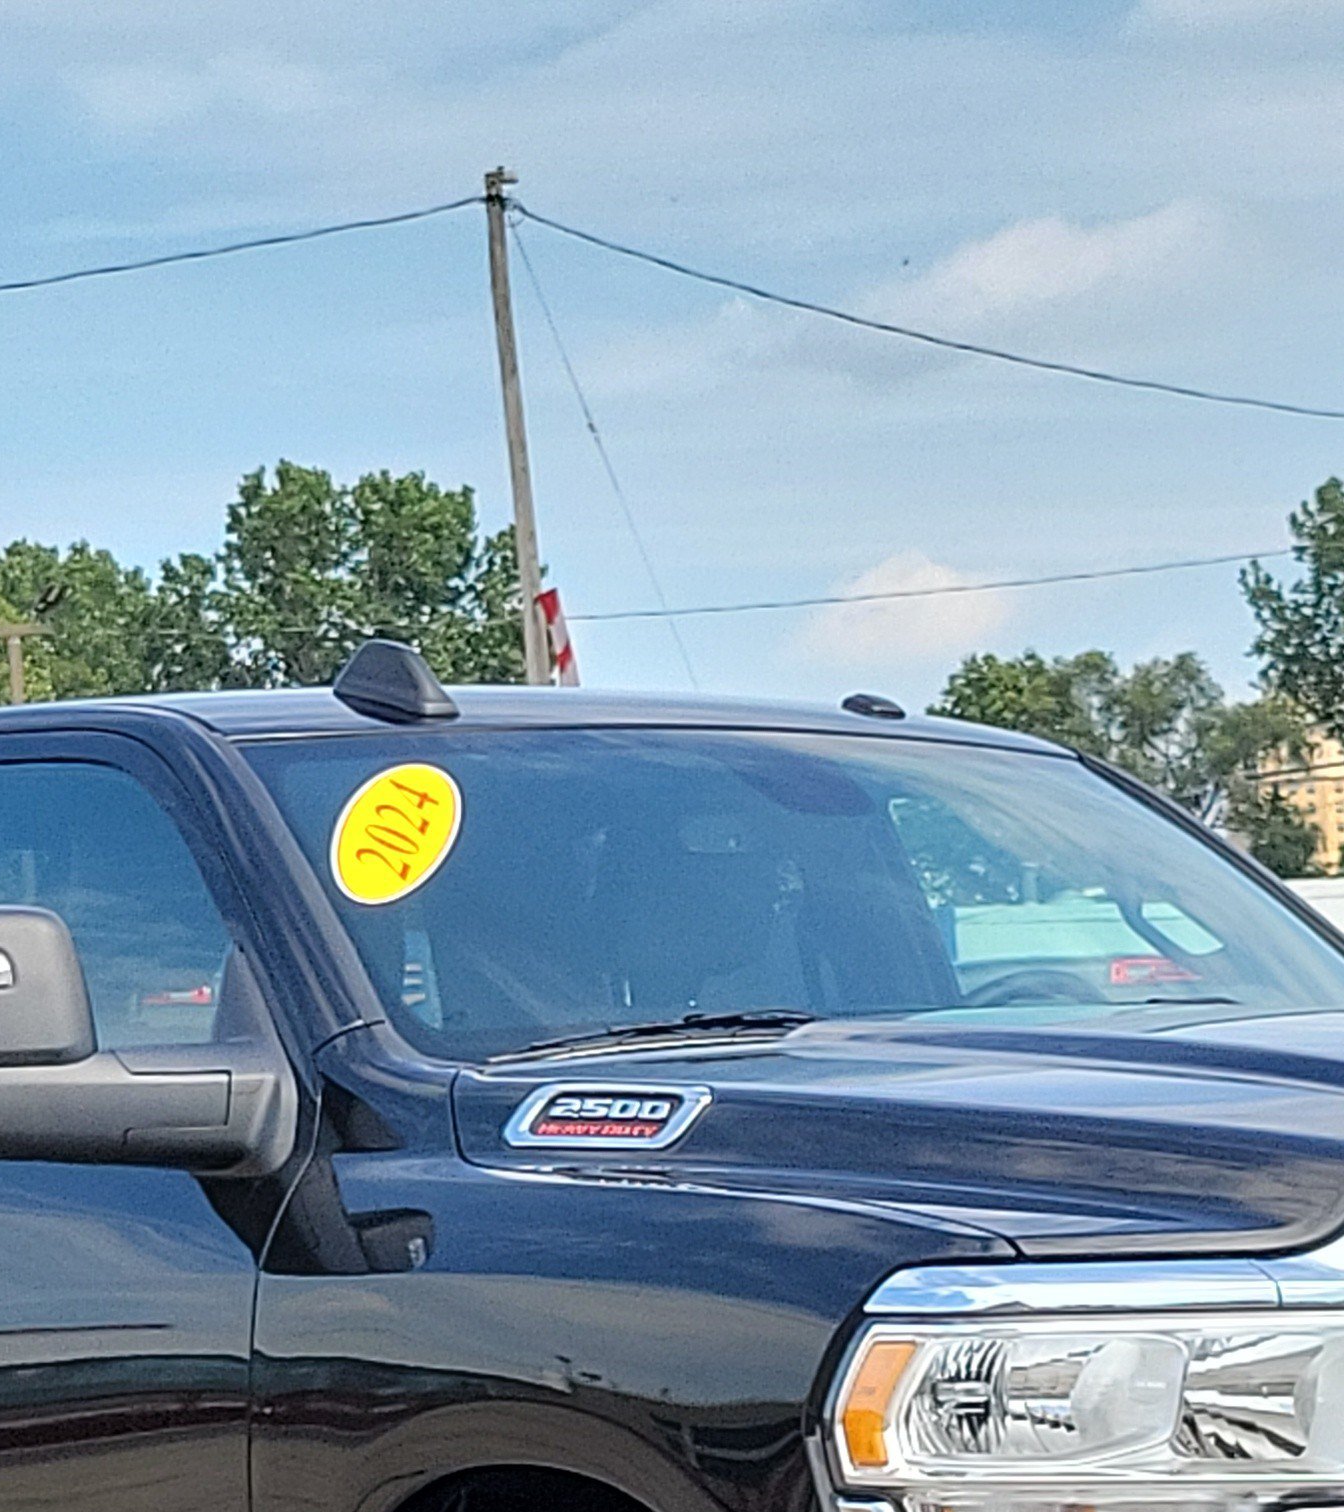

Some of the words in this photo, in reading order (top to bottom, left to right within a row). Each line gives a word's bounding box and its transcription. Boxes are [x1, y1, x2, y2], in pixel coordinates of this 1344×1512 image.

[355, 778, 440, 881] 2024
[548, 1097, 672, 1120] 2500
[537, 1122, 597, 1136] HEAVY
[599, 1123, 657, 1137] DUTY
